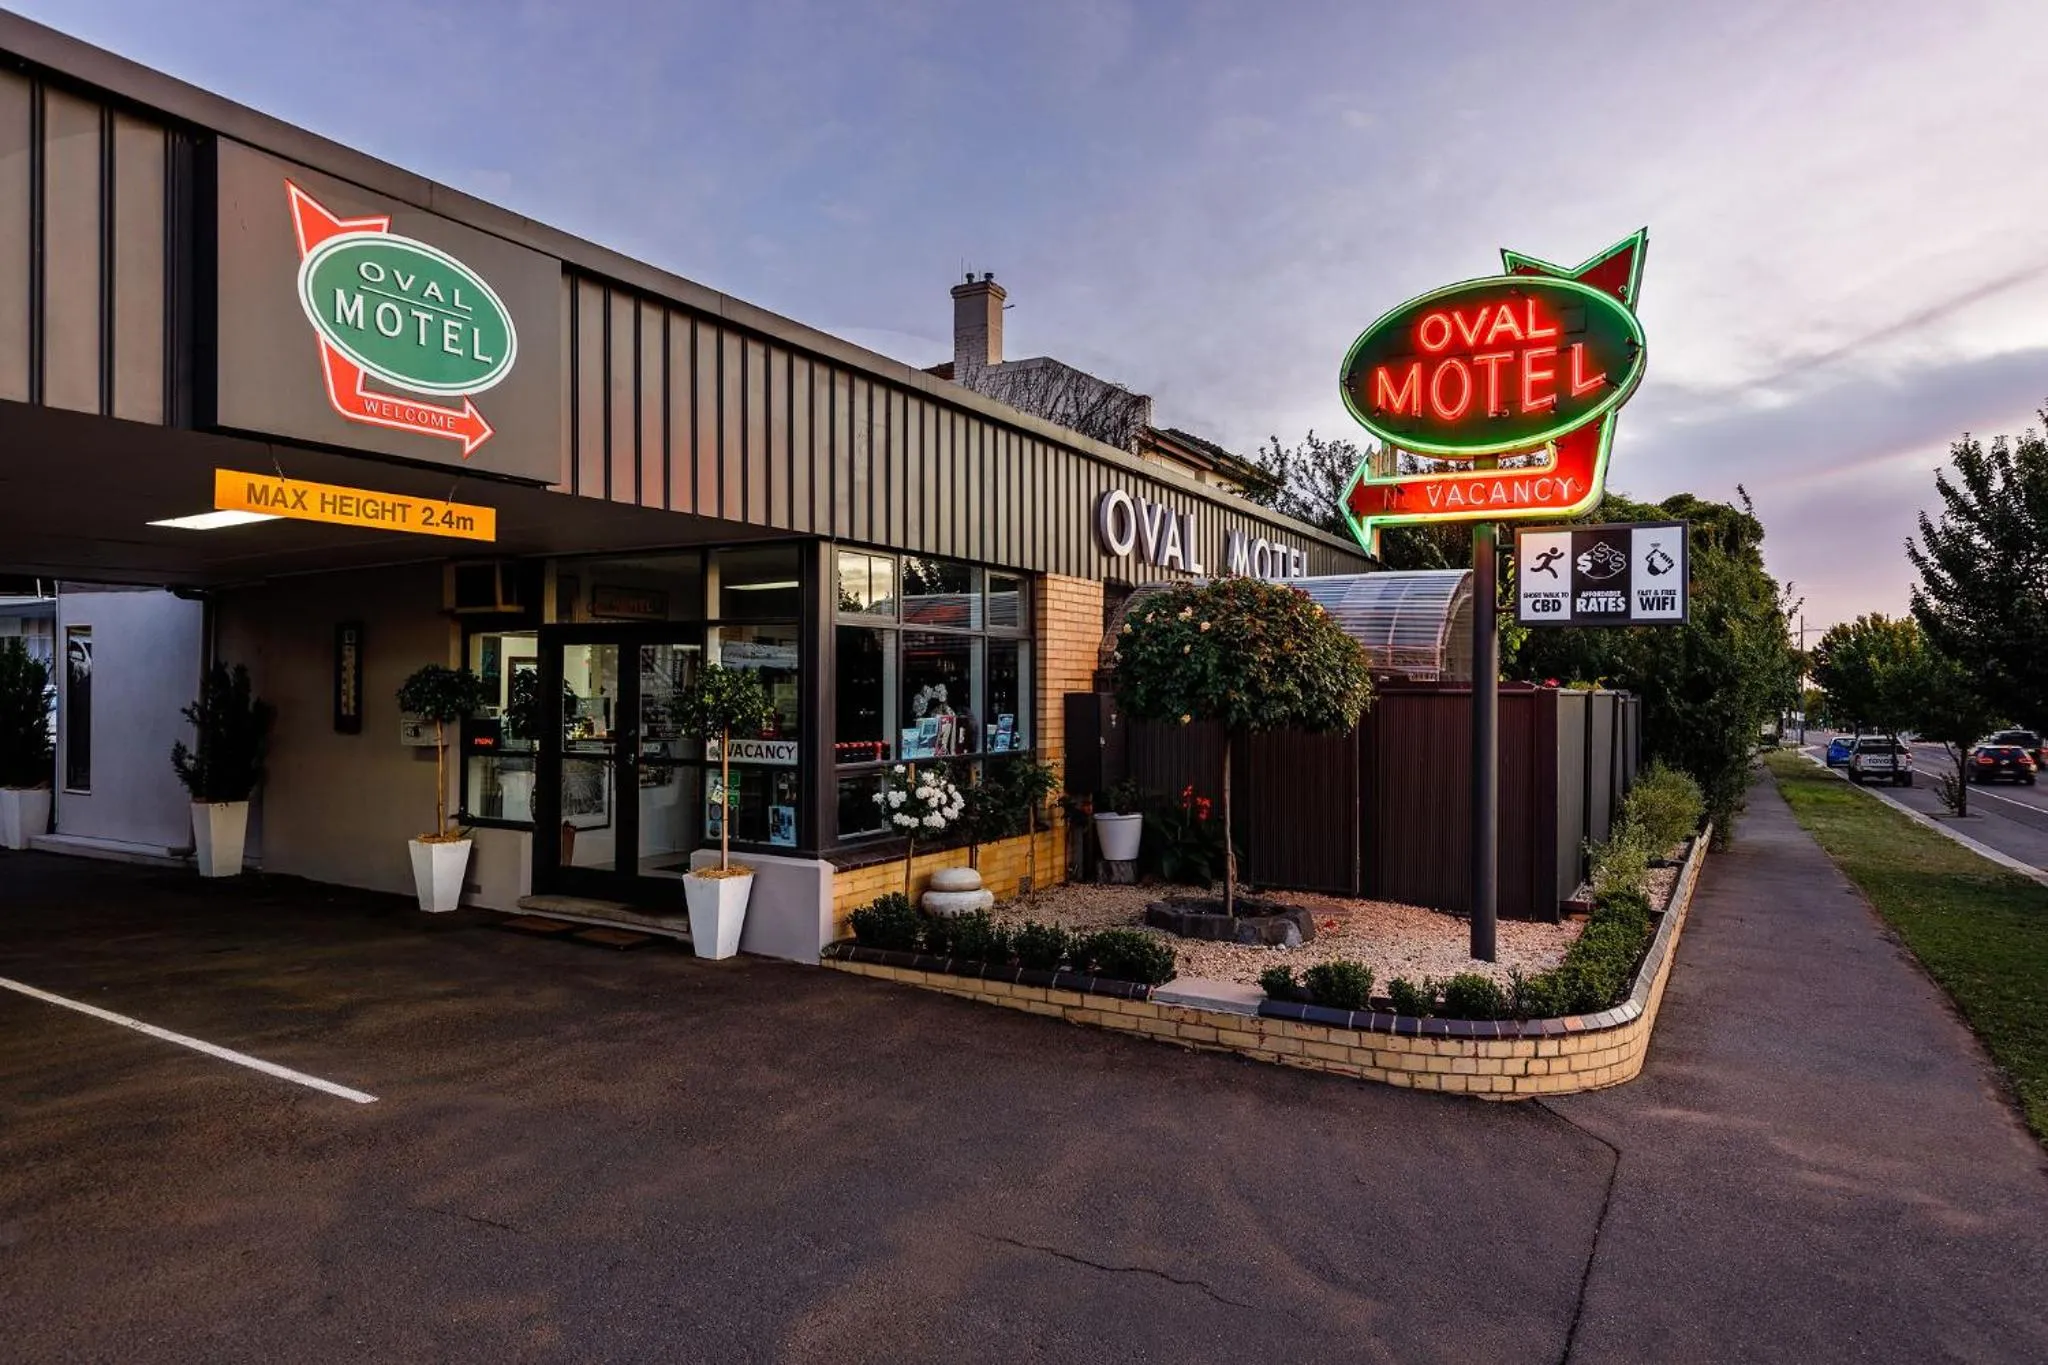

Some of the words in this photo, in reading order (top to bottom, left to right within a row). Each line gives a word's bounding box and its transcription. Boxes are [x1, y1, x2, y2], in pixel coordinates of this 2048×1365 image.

[359, 261, 473, 312] OVAL
[335, 288, 493, 364] MOTEL
[1420, 299, 1557, 351] OVAL
[1376, 343, 1606, 420] MOTEL
[364, 398, 456, 428] WELCOME
[246, 482, 308, 511] MAX
[320, 492, 412, 523] HEIGHT
[421, 506, 475, 531] 2.4m
[1426, 477, 1574, 507] VACANCY
[1100, 490, 1204, 574] OVAL
[1532, 599, 1562, 613] CBD
[1576, 597, 1626, 613] RATES
[1640, 596, 1676, 611] WIFI
[727, 743, 795, 760] VACANCY
